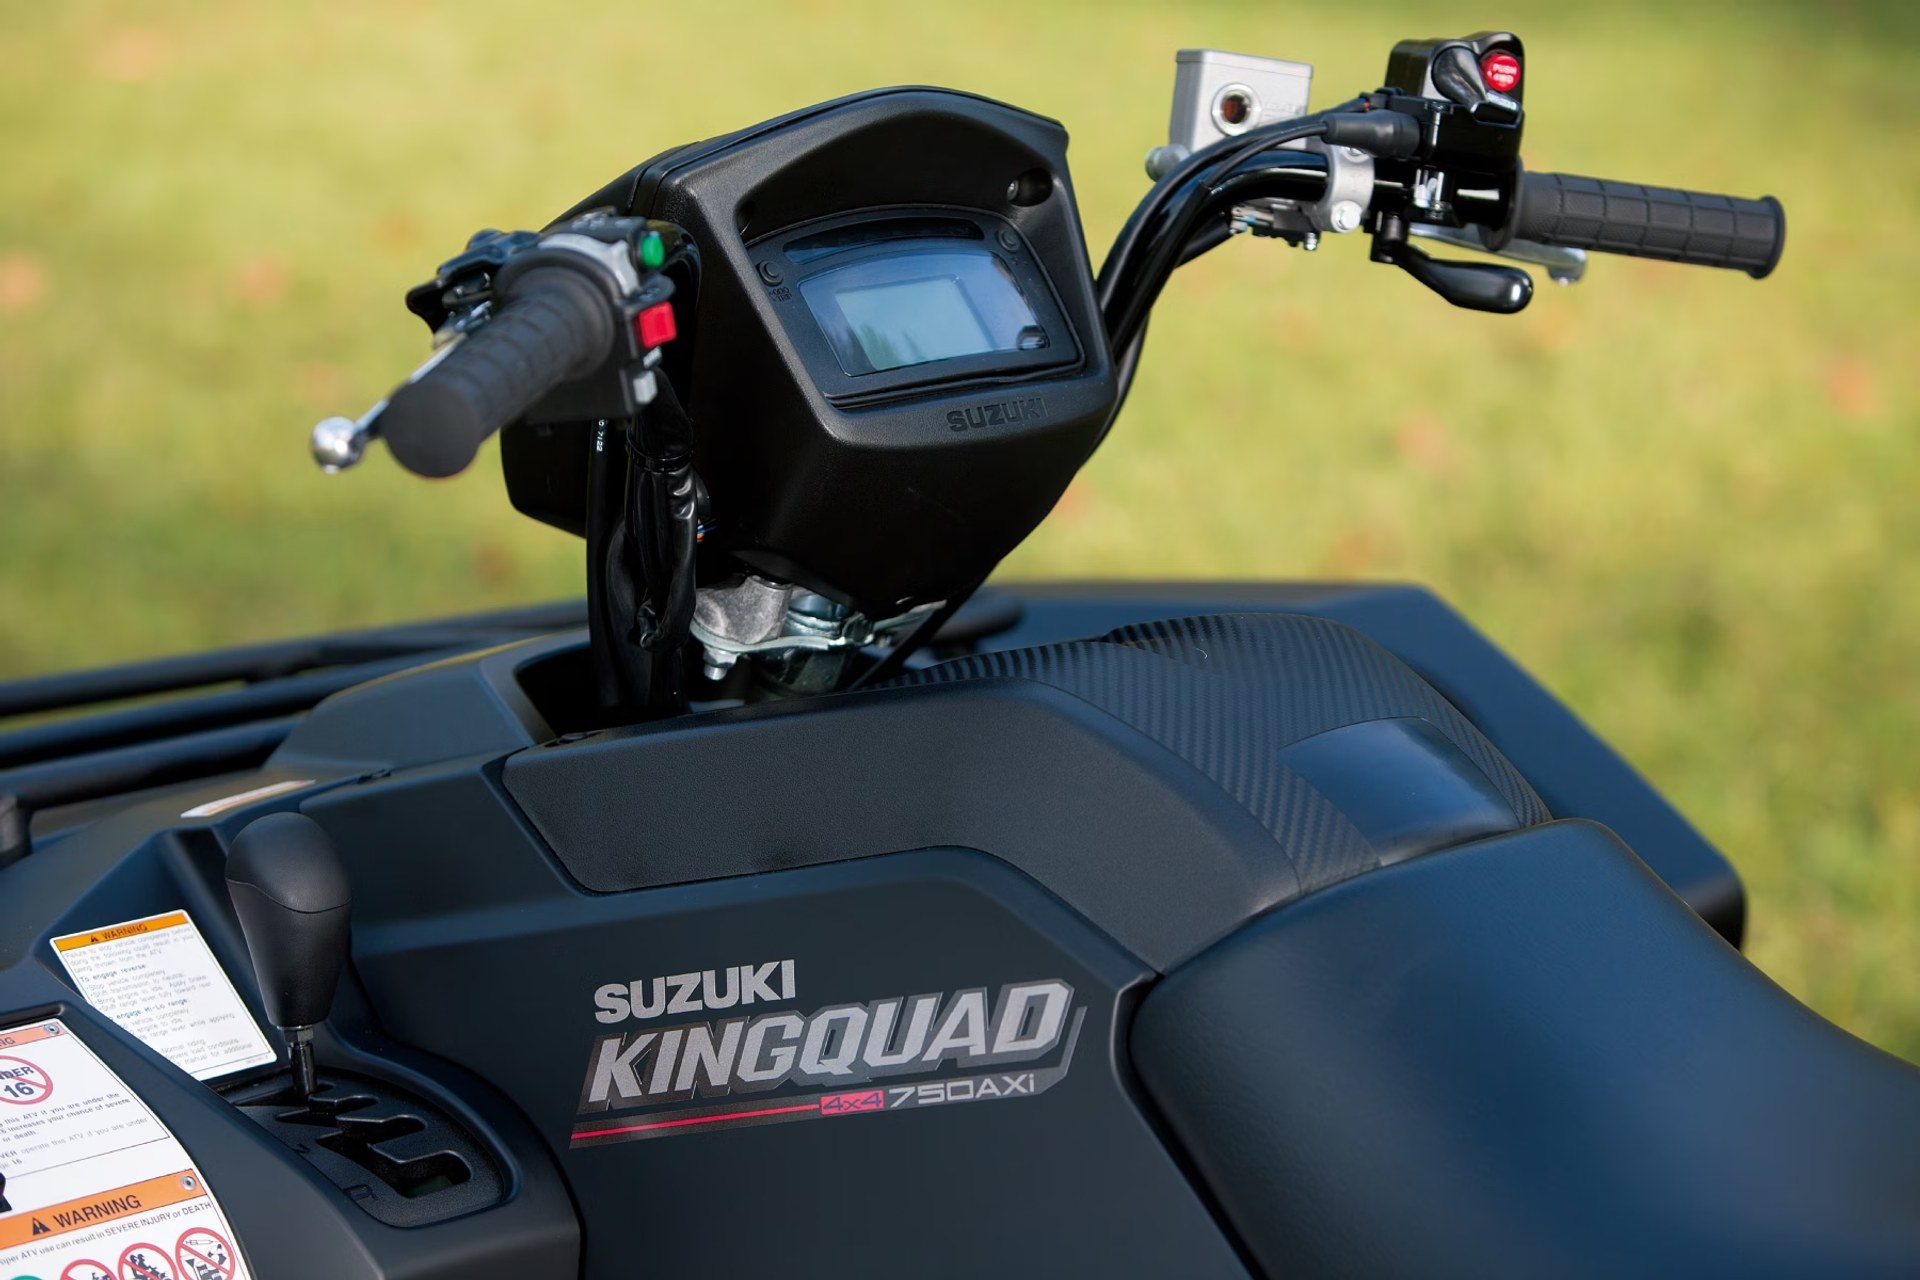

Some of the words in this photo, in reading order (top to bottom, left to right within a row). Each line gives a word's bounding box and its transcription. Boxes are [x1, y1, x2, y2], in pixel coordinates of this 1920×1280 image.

[946, 397, 1049, 432] SUZUKI
[103, 923, 148, 940] WARNING
[594, 959, 796, 1024] SUZUKI
[587, 982, 1071, 1103] KINGQUAD
[4, 1082, 35, 1098] 16
[822, 1092, 884, 1112] 4x4
[888, 1073, 1035, 1108] 750AXi
[53, 1194, 142, 1229] WARNING
[21, 1247, 38, 1260] ATV
[40, 1244, 55, 1255] use
[56, 1239, 71, 1250] can
[72, 1231, 96, 1246] result
[96, 1229, 105, 1239] in
[104, 1219, 141, 1237] SEVERE
[140, 1211, 171, 1226] INJURY
[172, 1209, 182, 1218] or
[181, 1201, 212, 1215] DEATH
